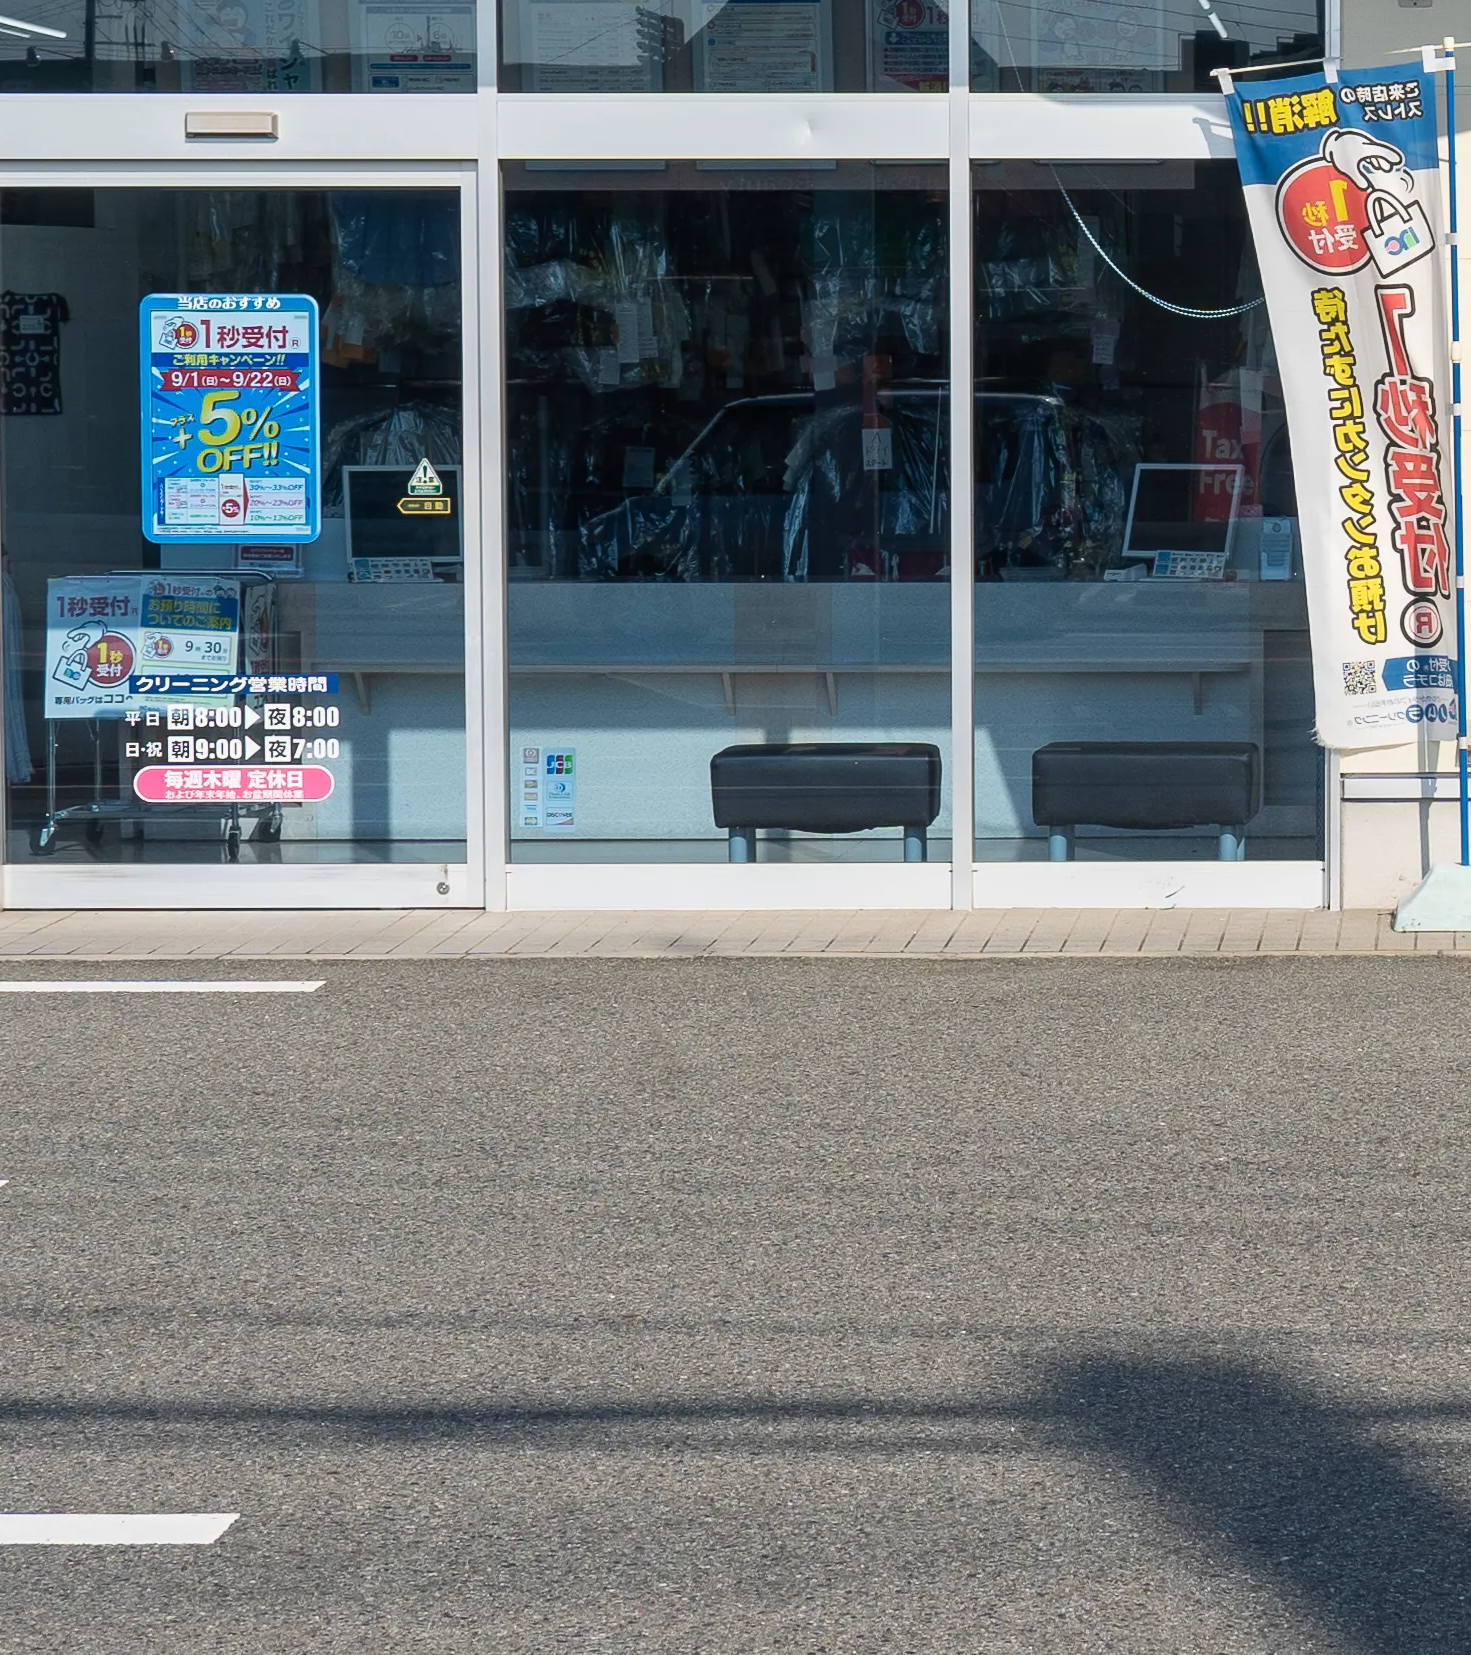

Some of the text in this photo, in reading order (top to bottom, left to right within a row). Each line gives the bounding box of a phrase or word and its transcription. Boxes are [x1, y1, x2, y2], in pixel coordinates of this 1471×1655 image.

[177, 296, 281, 310] 当店のおすすめ
[200, 319, 289, 349] 1秒受付
[1202, 429, 1244, 459] Tax
[196, 441, 279, 473] OFF!!
[1199, 469, 1254, 495] Free
[56, 596, 130, 618] 1秒受付
[96, 642, 124, 664] 1秒
[96, 663, 123, 678] 受付
[135, 676, 328, 693] クリーニング営業時間
[124, 710, 160, 727] 平日
[164, 770, 304, 789] 毎週木曜 定休日
